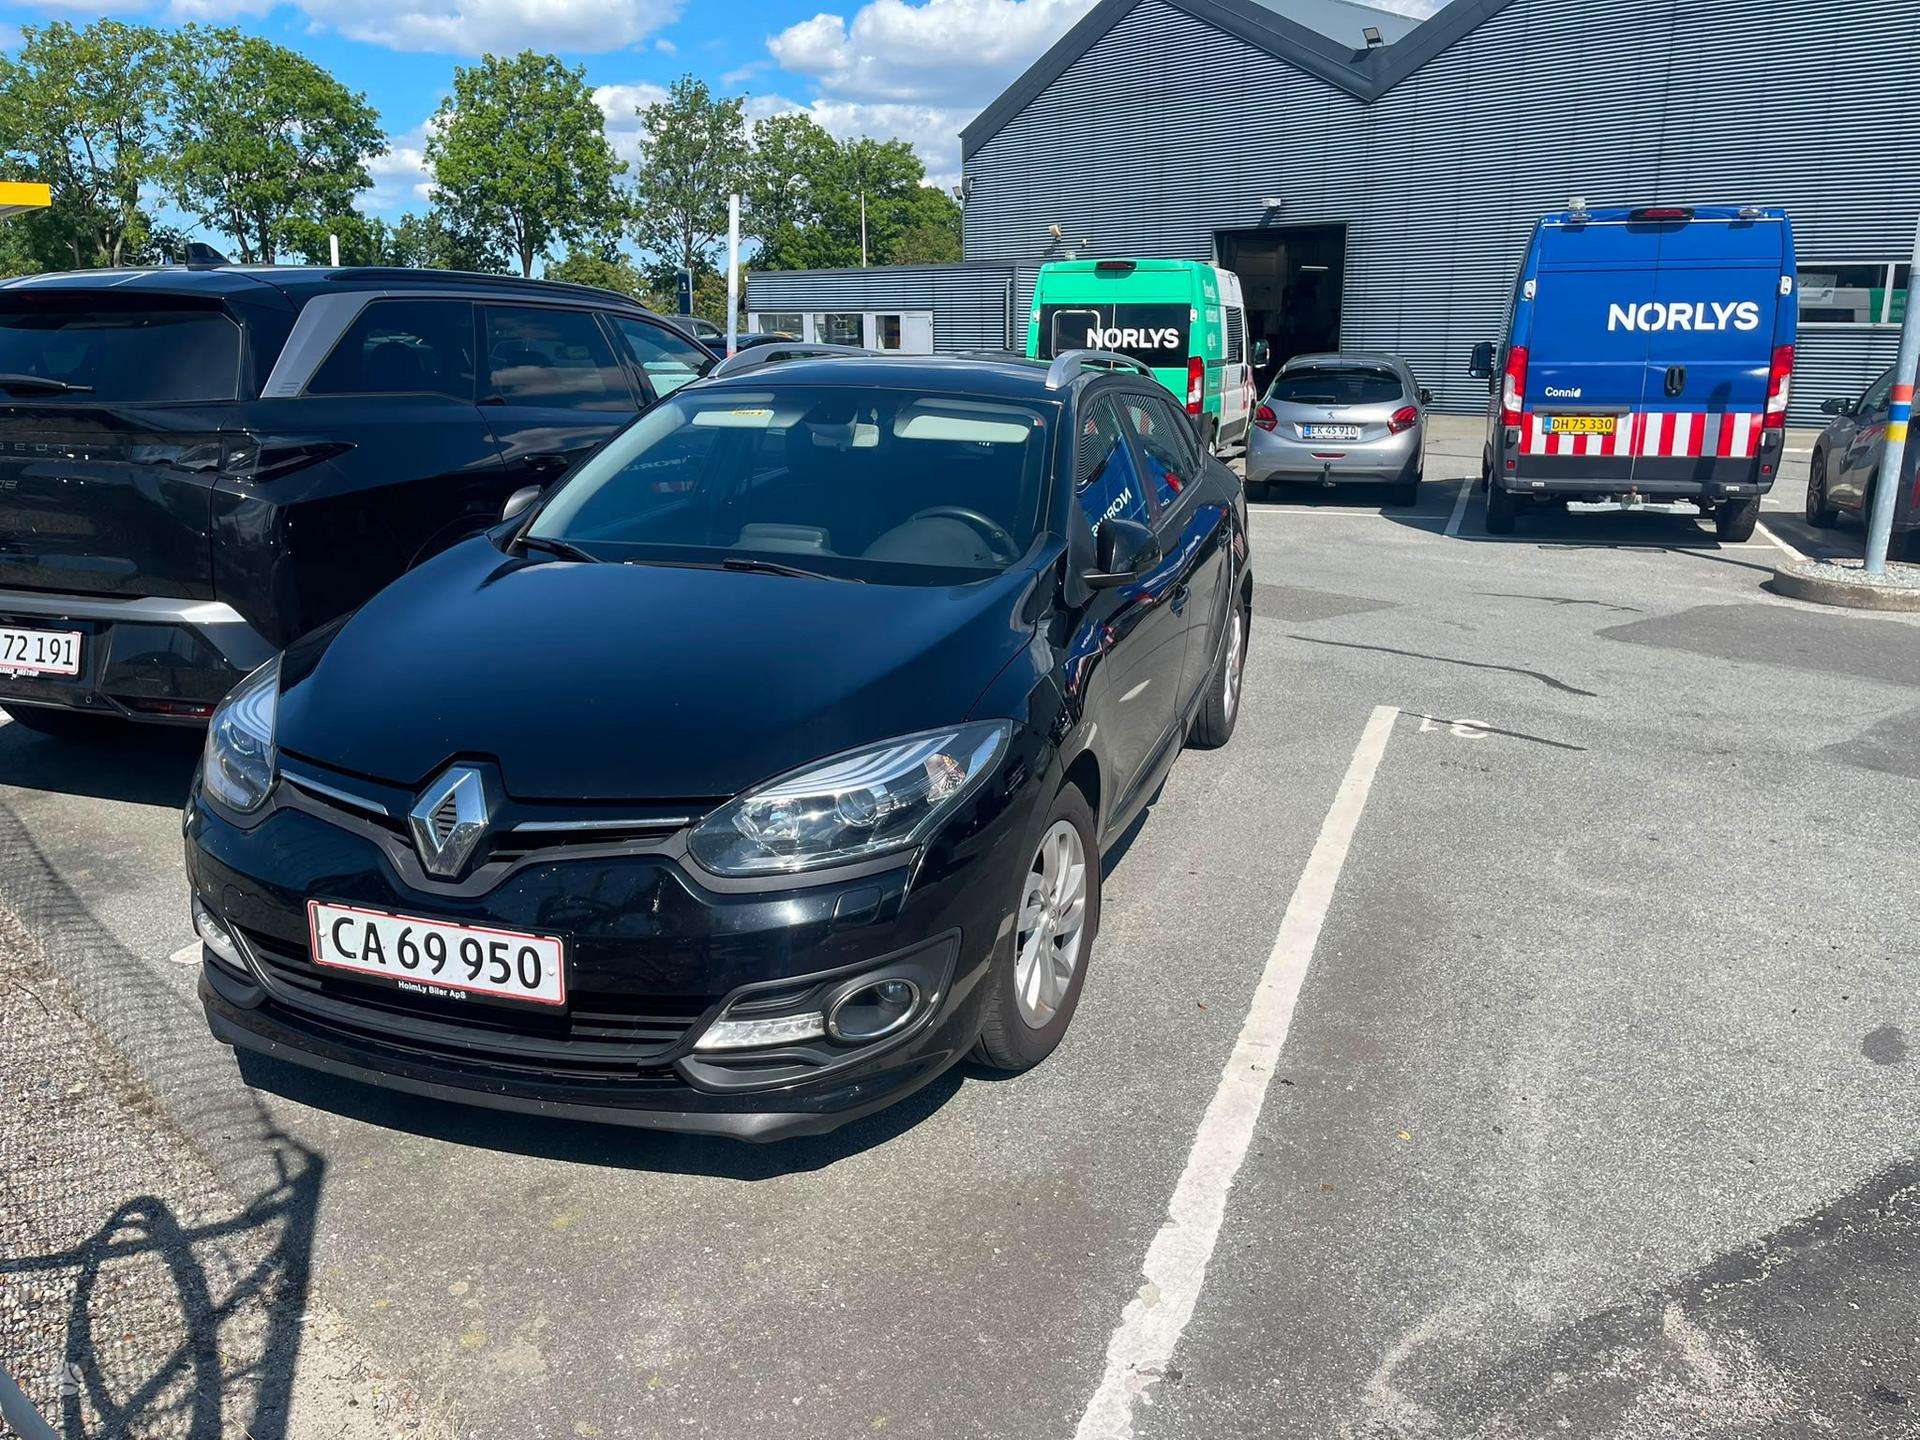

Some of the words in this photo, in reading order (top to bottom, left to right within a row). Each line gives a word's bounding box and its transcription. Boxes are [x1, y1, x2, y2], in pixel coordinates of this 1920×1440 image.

[1607, 301, 1759, 331] NORLYS
[1086, 328, 1180, 348] NORLYS
[1312, 425, 1323, 435] EK
[1339, 425, 1357, 435] 910
[1552, 419, 1569, 430] DH
[1572, 419, 1586, 430] 75
[1589, 419, 1612, 430] 330
[4, 634, 28, 660] 72
[35, 637, 73, 665] 191
[331, 917, 387, 965] CA
[397, 926, 447, 976] 69
[459, 937, 542, 990] 950
[428, 985, 448, 996] Biler
[449, 989, 467, 1000] ApS
